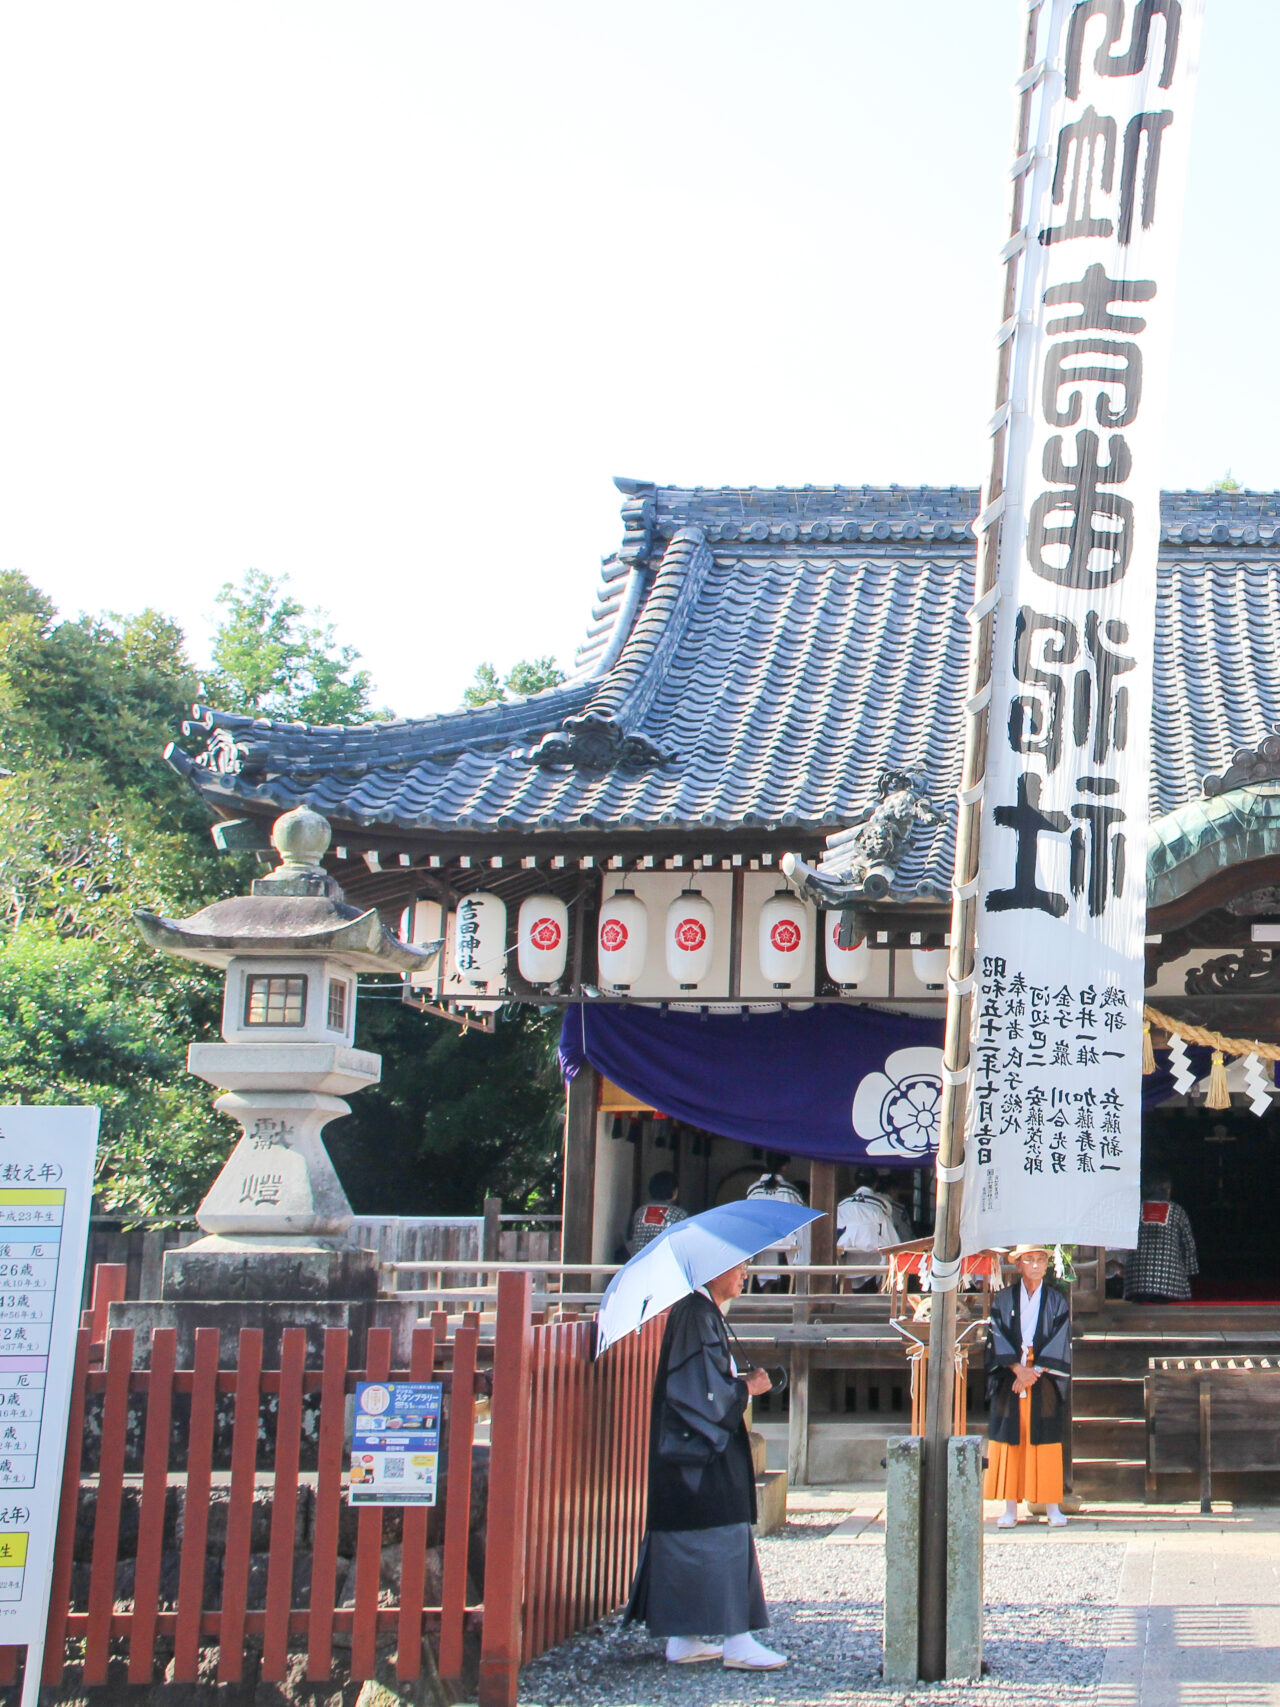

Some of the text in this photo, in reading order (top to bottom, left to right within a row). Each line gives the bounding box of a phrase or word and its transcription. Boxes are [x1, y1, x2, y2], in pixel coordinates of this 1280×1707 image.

[460, 899, 484, 970] 吉田神社
[0, 1263, 34, 1277] 26歳
[0, 1327, 27, 1341] 2歳
